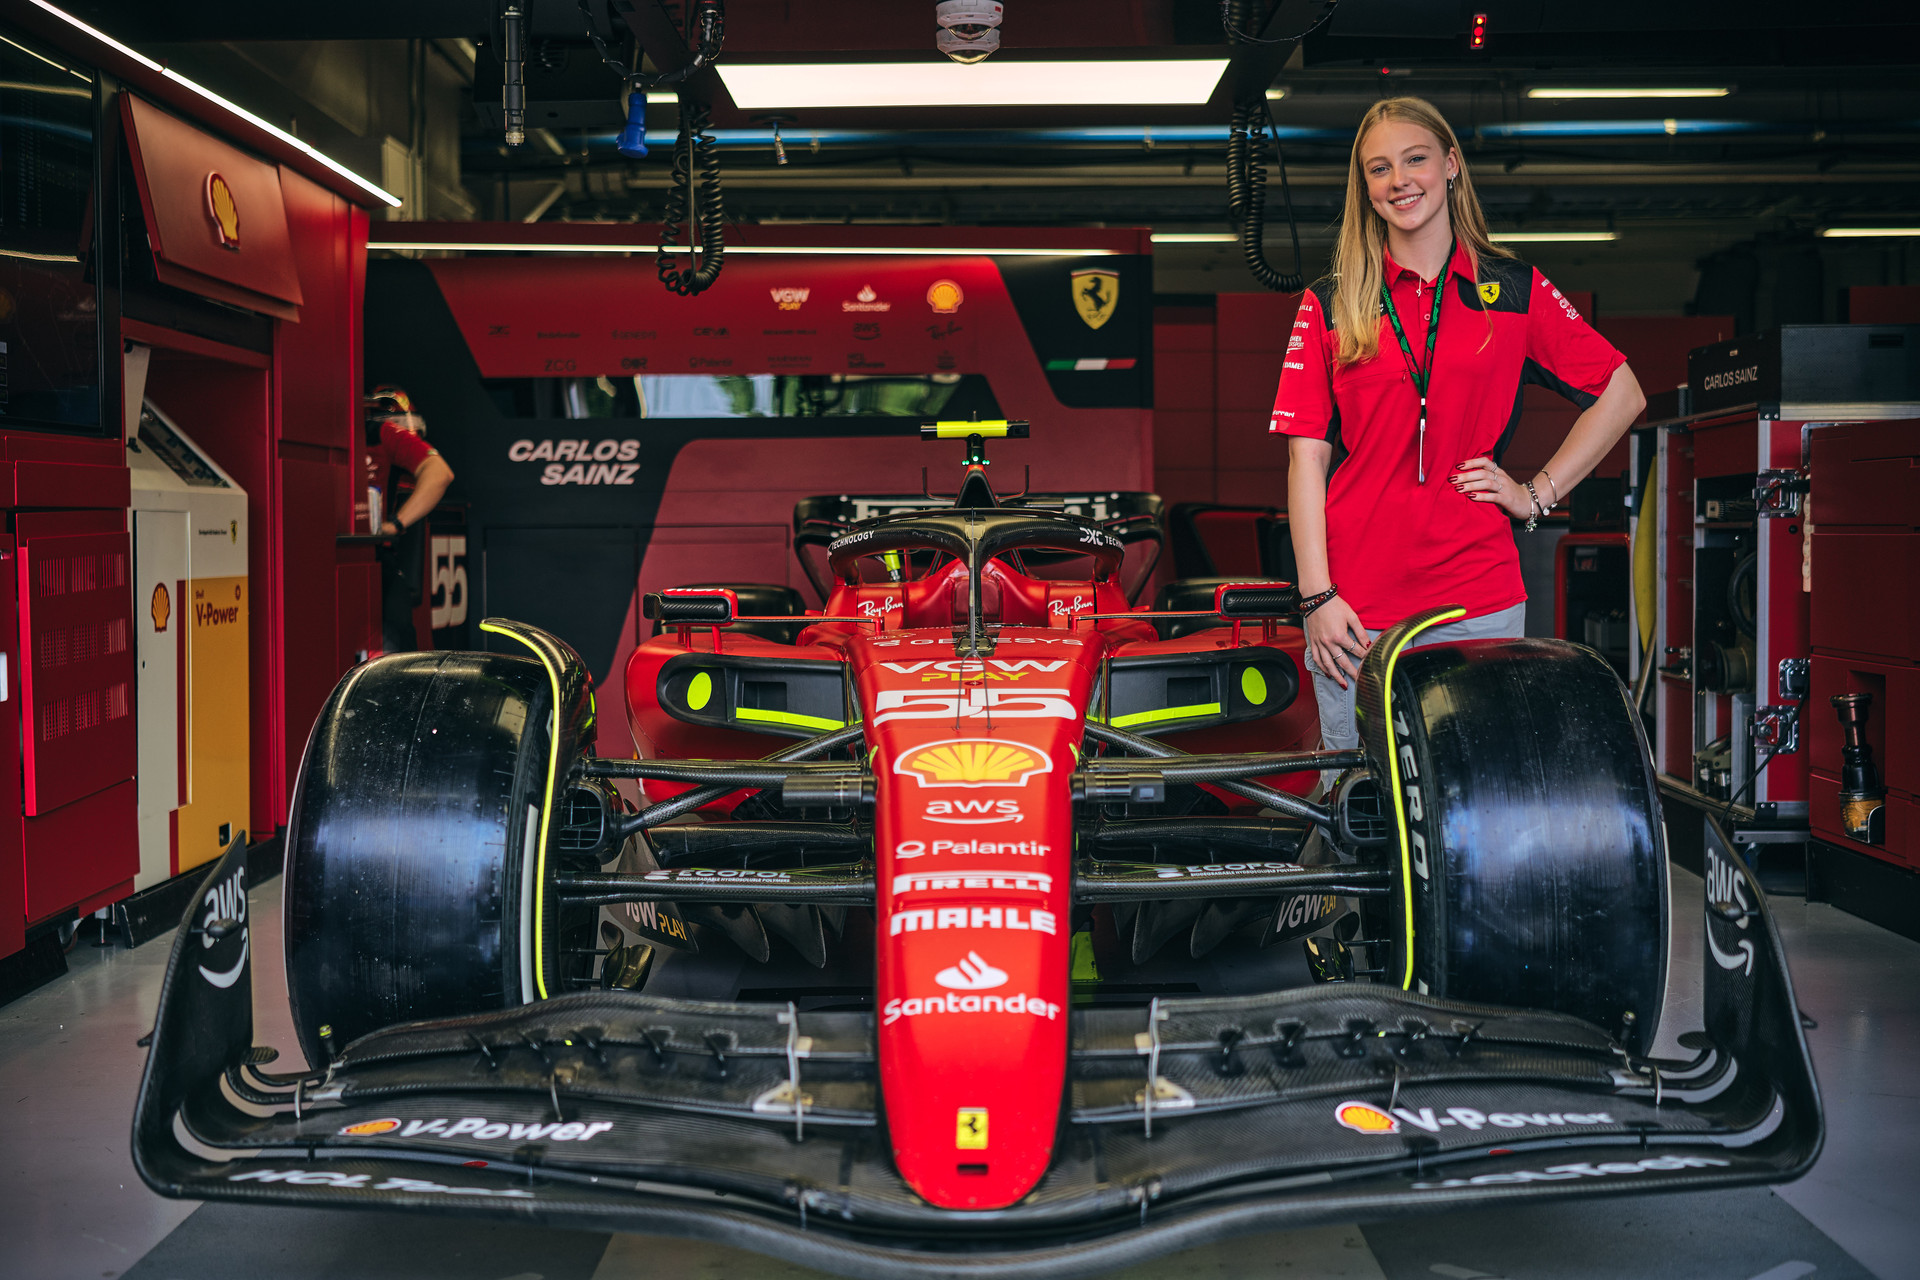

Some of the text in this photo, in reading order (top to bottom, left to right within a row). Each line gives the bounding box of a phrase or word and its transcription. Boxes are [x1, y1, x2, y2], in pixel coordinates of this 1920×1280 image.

[770, 287, 810, 303] VGW
[841, 301, 891, 313] Santander
[1704, 365, 1758, 391] CARLOS SAINZ
[507, 439, 641, 462] CARLOS
[540, 464, 641, 486] SAINZ
[430, 535, 468, 630] 55
[196, 602, 239, 628] V-Power
[910, 636, 1084, 647] GEESYS
[880, 659, 1069, 674] VGW
[921, 671, 1029, 682] PLAY
[873, 688, 1078, 728] 55
[925, 799, 1020, 815] aws
[1394, 710, 1430, 881] ZERO
[932, 839, 1052, 857] Palantir
[678, 869, 791, 880] ECOPOL
[1186, 862, 1302, 873] ECOPOL
[892, 870, 1053, 896] PIRELLI
[1706, 847, 1749, 930] aws
[204, 864, 246, 949] aws
[1275, 894, 1323, 933] VGW
[657, 912, 688, 942] PLAY
[890, 907, 1057, 936] MAHLE
[883, 992, 1061, 1026] Santander
[401, 1117, 614, 1141] V-Power
[1392, 1107, 1615, 1133] V-Power
